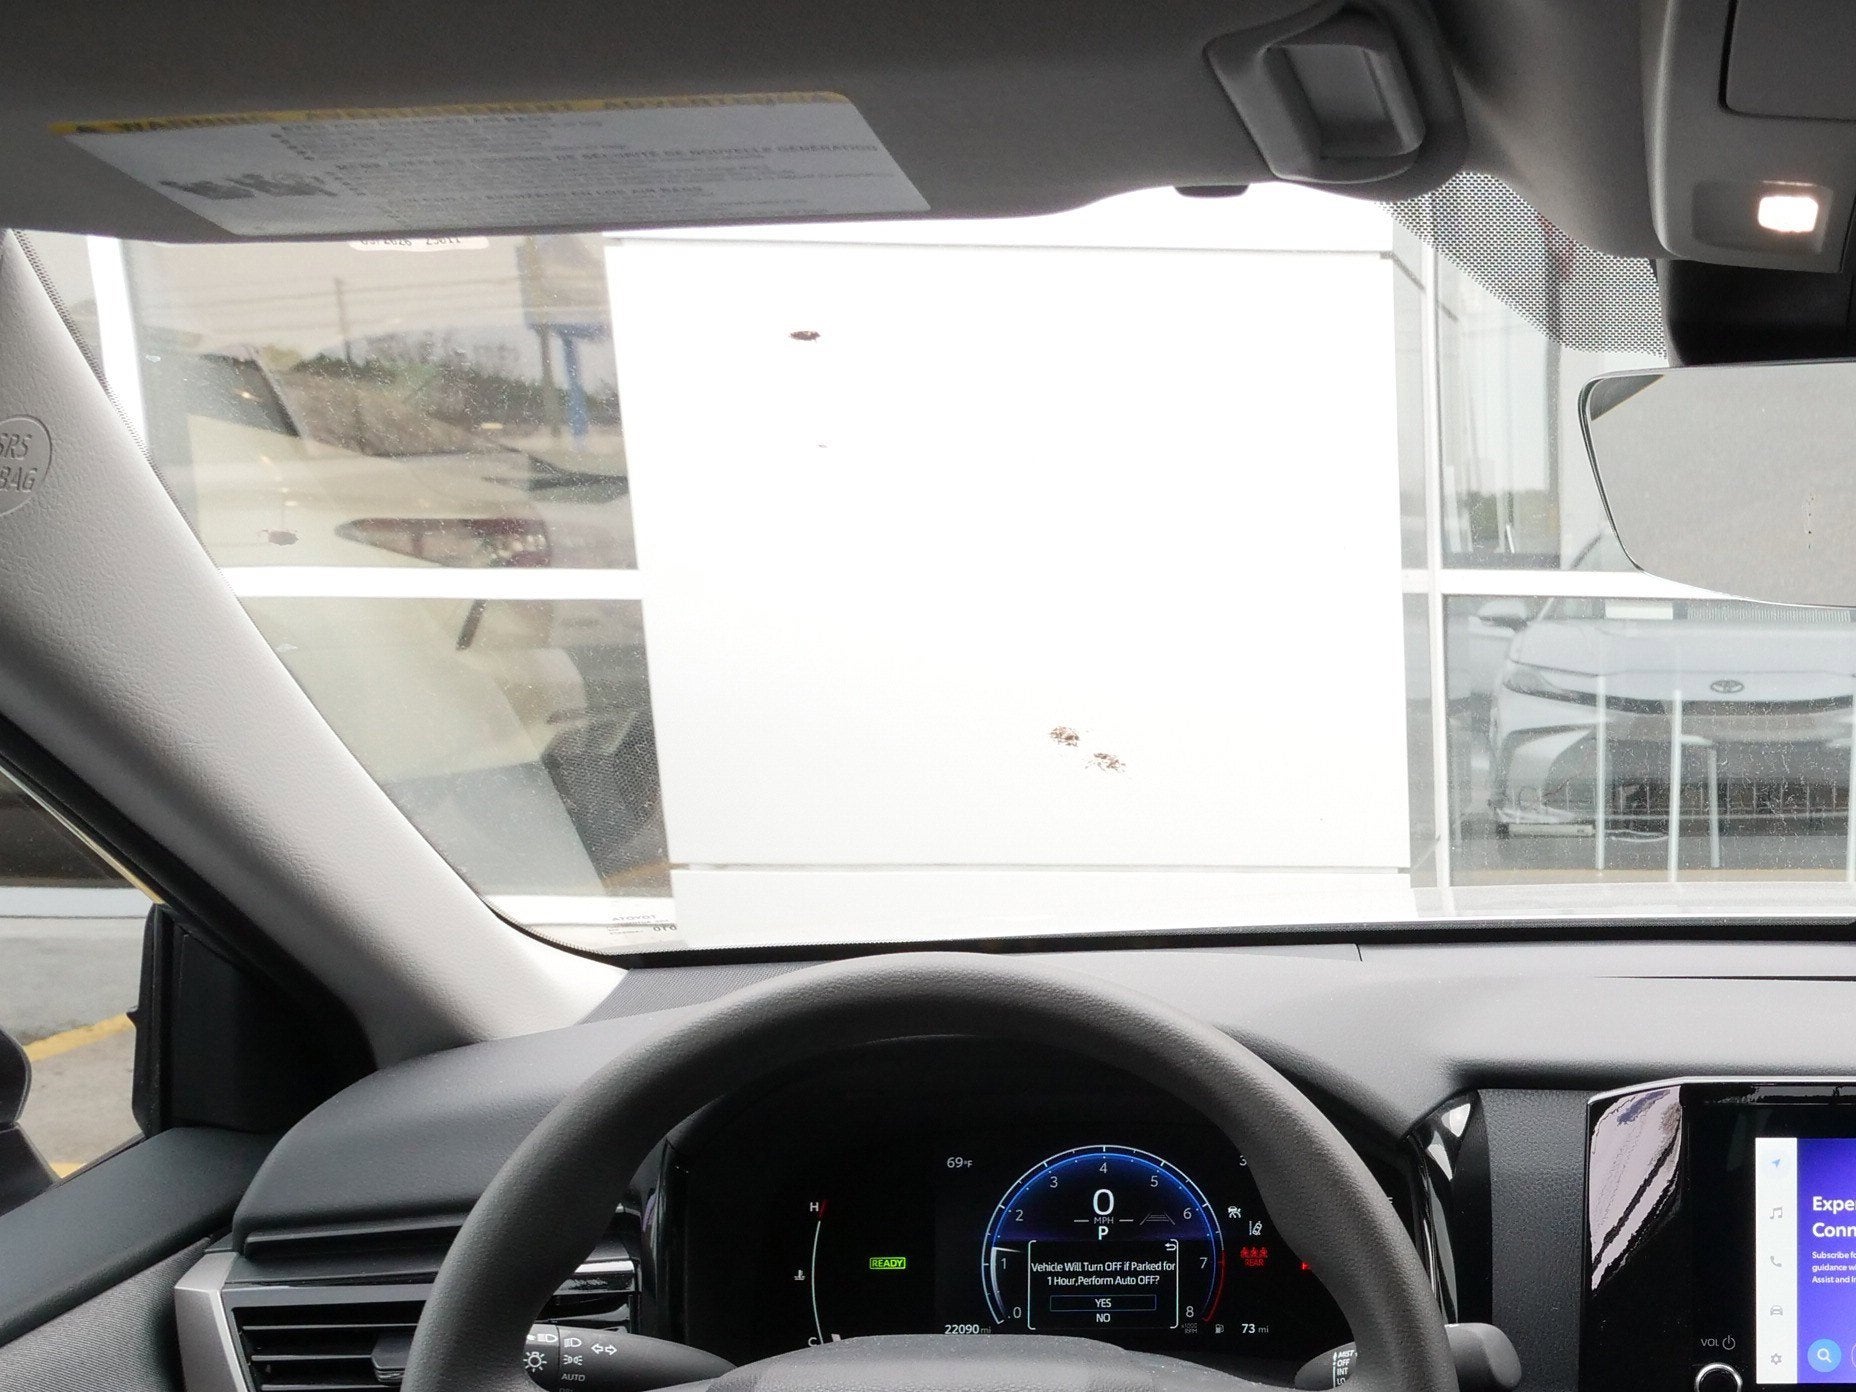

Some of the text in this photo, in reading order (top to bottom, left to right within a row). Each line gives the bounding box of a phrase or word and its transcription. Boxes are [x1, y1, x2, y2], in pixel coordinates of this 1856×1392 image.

[1099, 1162, 1108, 1174] 4
[1049, 1176, 1058, 1188] 3
[1150, 1175, 1158, 1187] 5
[809, 1201, 819, 1212] H
[1092, 1188, 1115, 1216] 0
[1015, 1209, 1024, 1222] 2
[1183, 1207, 1192, 1219] 6
[1098, 1226, 1109, 1240] P
[1811, 1251, 1850, 1259] Subscribe
[871, 1258, 905, 1268] READY
[1001, 1258, 1007, 1270] 1
[1031, 1262, 1175, 1272] Vehicle Will Turn OFF if Parked for
[1200, 1257, 1208, 1269] 7
[1245, 1258, 1265, 1267] REAR
[1812, 1264, 1847, 1273] guidance
[1047, 1276, 1052, 1286] 1
[1115, 1276, 1136, 1285] Auto
[1137, 1276, 1160, 1285] OFF?
[1812, 1276, 1835, 1284] Assist
[1835, 1276, 1850, 1284] and
[1095, 1298, 1112, 1308] YES
[1013, 1307, 1022, 1319] 0
[1185, 1306, 1194, 1317] 8
[1096, 1314, 1111, 1323] NO
[944, 1324, 992, 1335] 22090 mi
[1241, 1324, 1269, 1334] 73 mi
[807, 1336, 818, 1347] C
[1700, 1338, 1720, 1347] VOL
[1337, 1359, 1350, 1367] OFF
[1336, 1367, 1348, 1375] INT
[561, 1373, 586, 1382] AUTO
